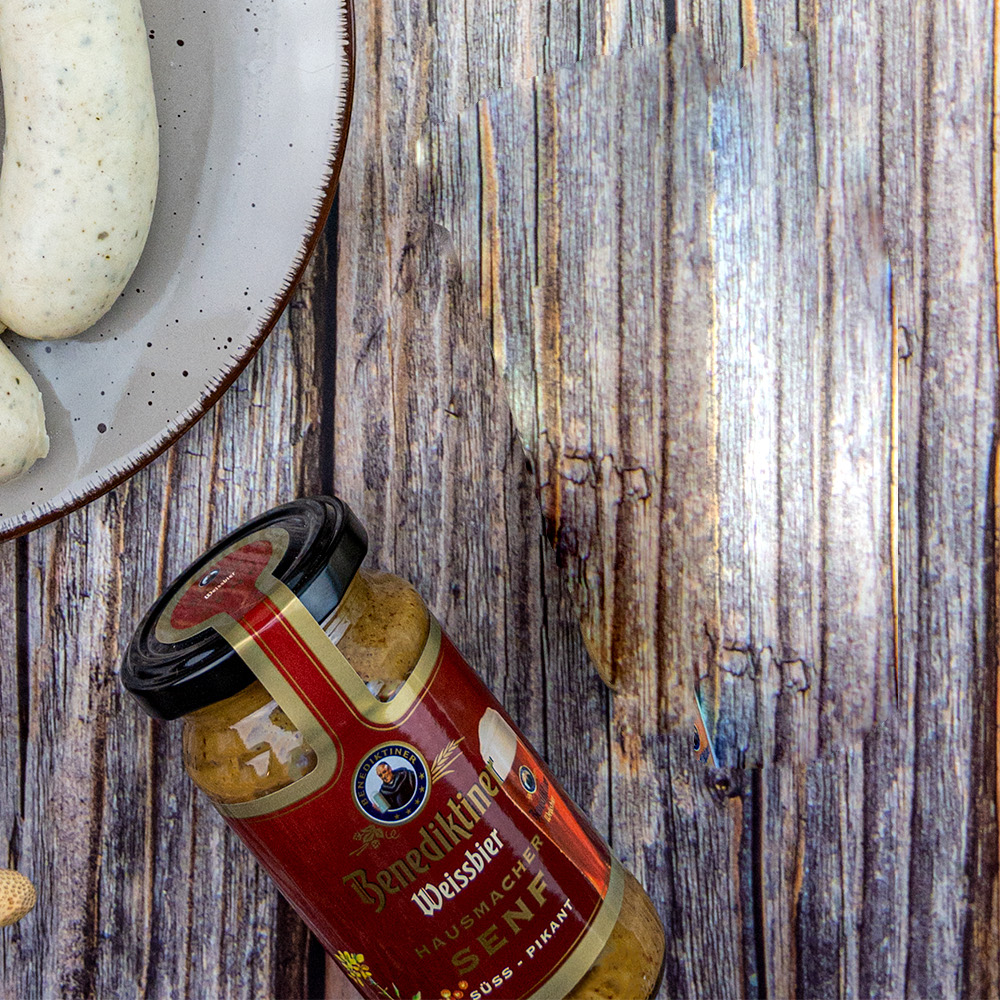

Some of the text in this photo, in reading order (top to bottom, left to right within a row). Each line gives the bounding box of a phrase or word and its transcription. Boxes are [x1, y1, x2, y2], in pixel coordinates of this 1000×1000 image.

[357, 747, 417, 806] BENEDIKTINER
[342, 756, 505, 913] Benediktiner
[411, 828, 504, 916] Weissbier
[414, 834, 544, 959] HAUSMACHER
[451, 869, 548, 975] SENF
[469, 966, 513, 1000] SÜSS
[526, 898, 574, 959] PIKANT
